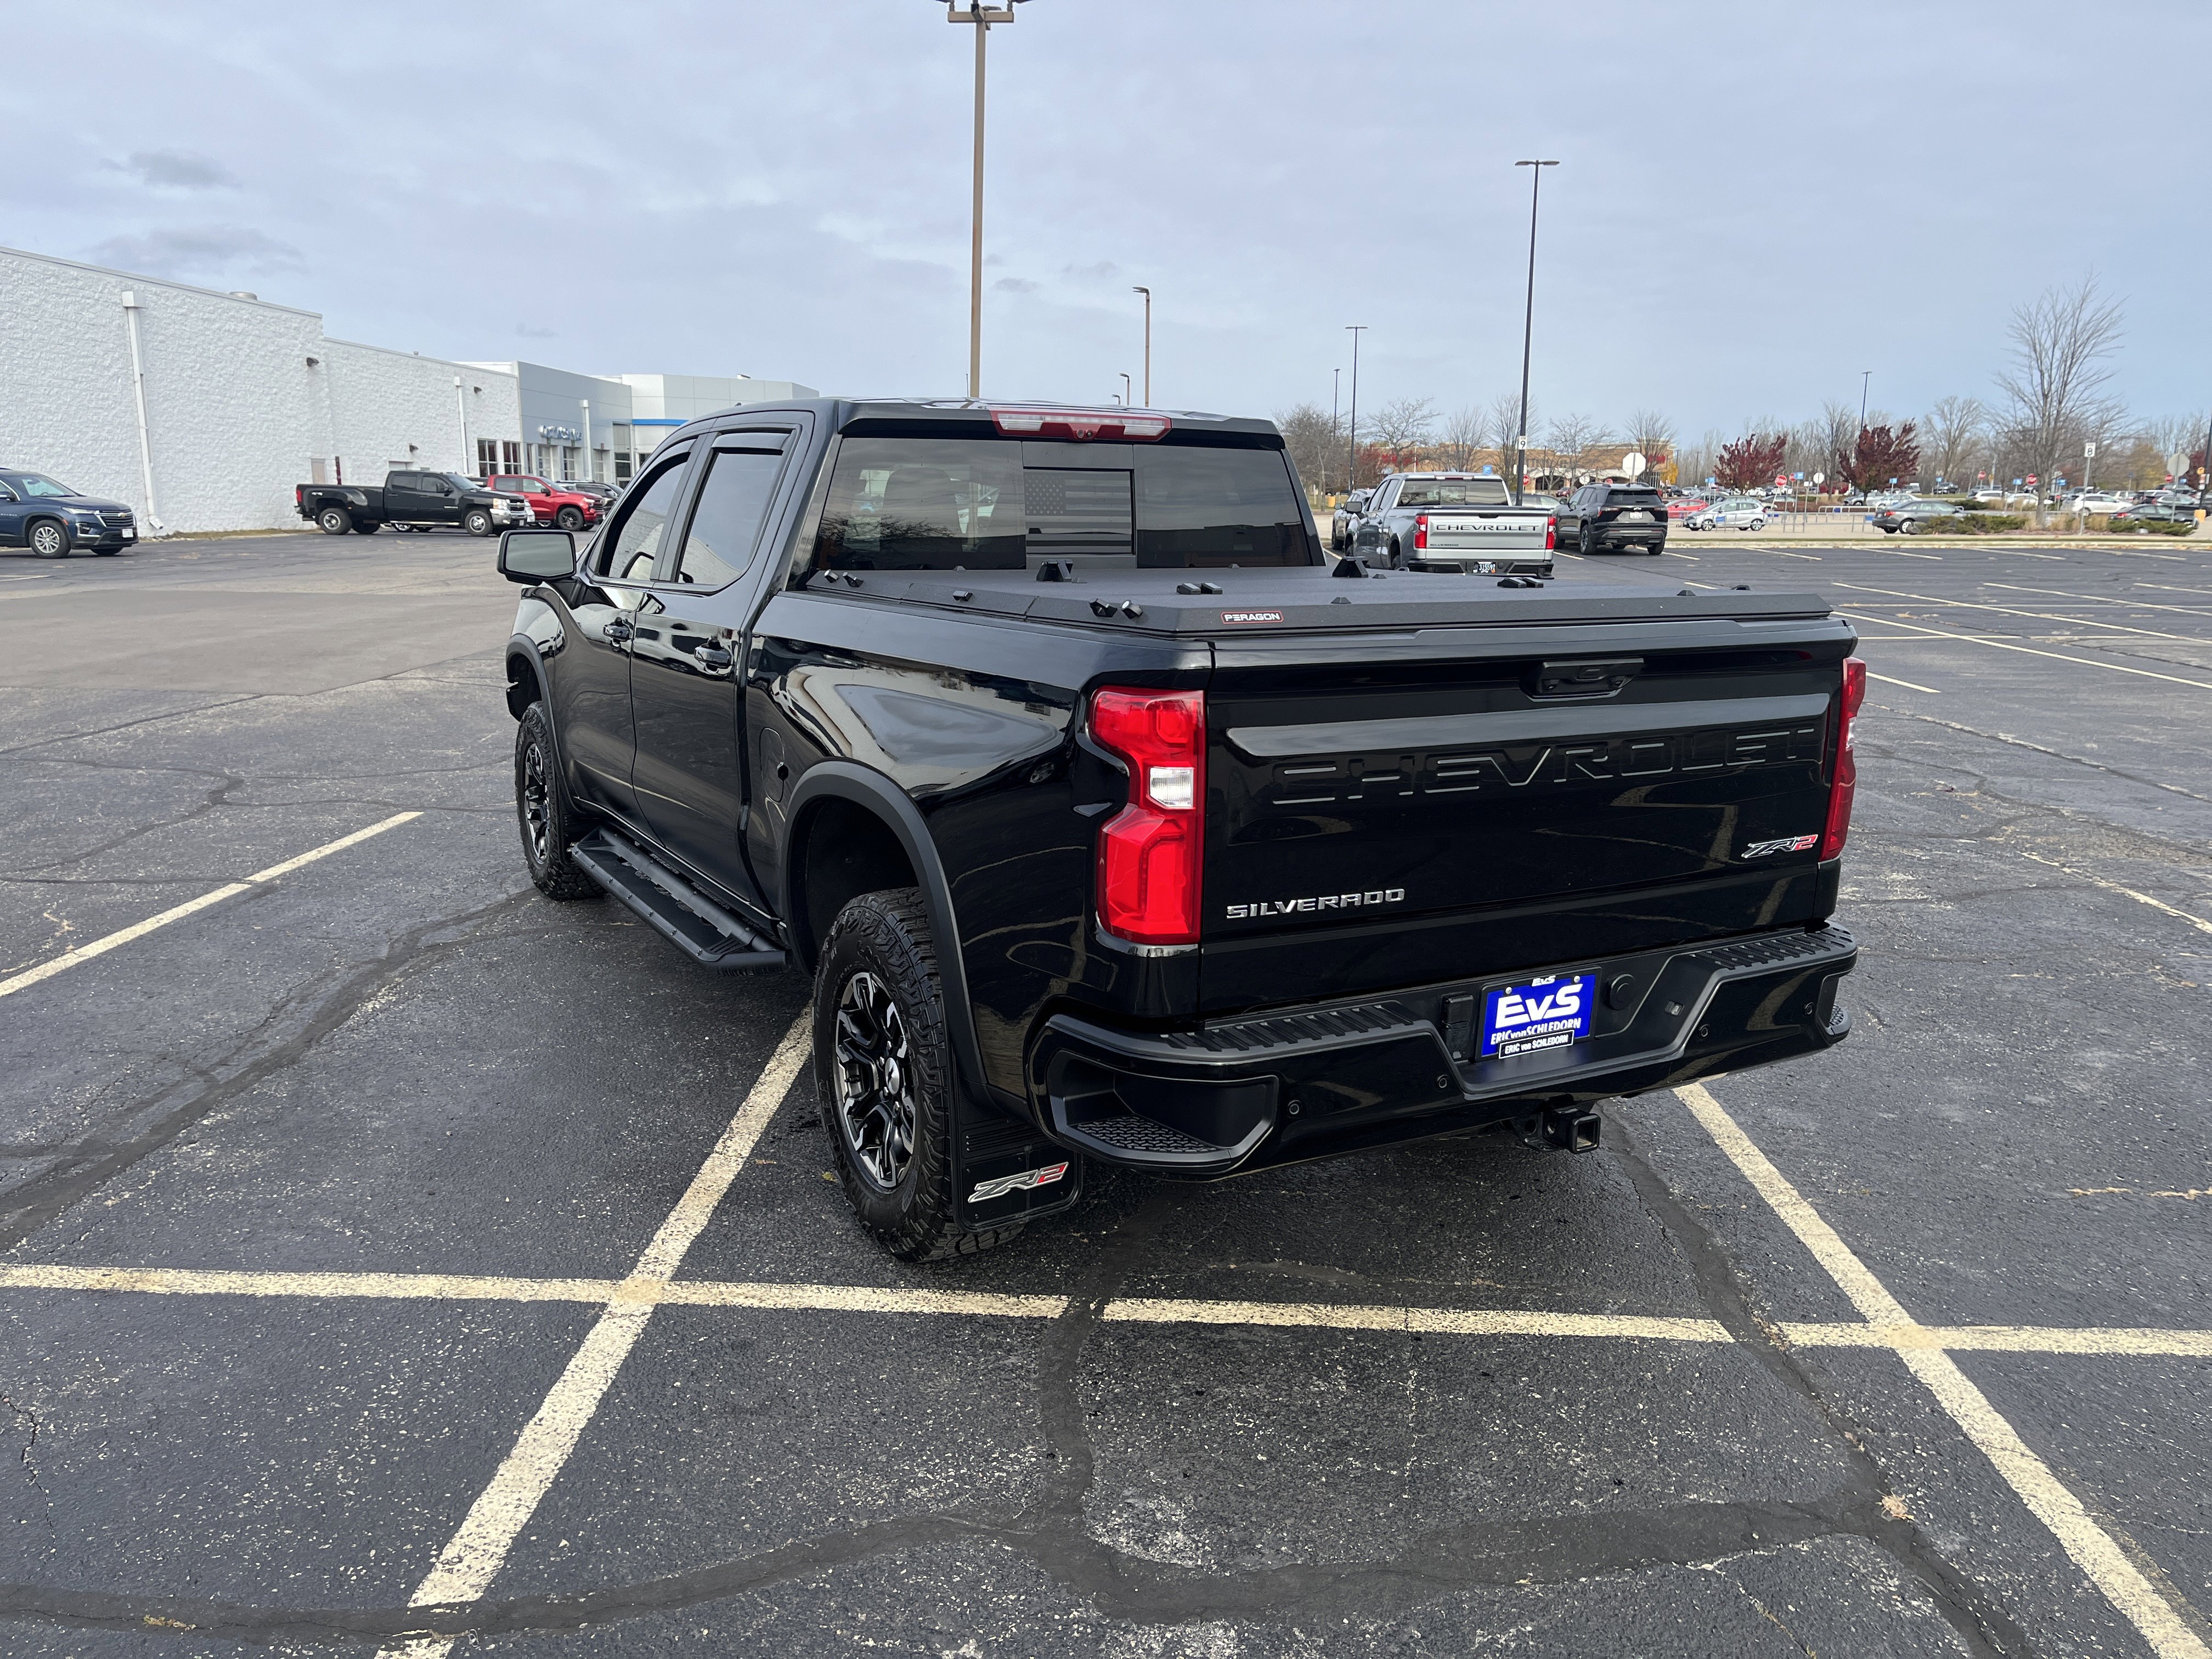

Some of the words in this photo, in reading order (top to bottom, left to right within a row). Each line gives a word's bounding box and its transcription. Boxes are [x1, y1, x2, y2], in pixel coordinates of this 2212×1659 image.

[1520, 441, 1526, 449] 9
[1224, 613, 1280, 622] PERAGON
[1272, 726, 1815, 804] CHEVROLET
[1741, 834, 1819, 859] ZR2
[1226, 888, 1406, 919] SILVERADO
[1531, 975, 1556, 987] EvS
[1495, 984, 1583, 1029] EvS
[1504, 1043, 1521, 1054] ERIC
[1521, 1042, 1531, 1051] von
[1532, 1034, 1569, 1049] SCHLEDORN
[967, 1161, 1069, 1204] ZR2
